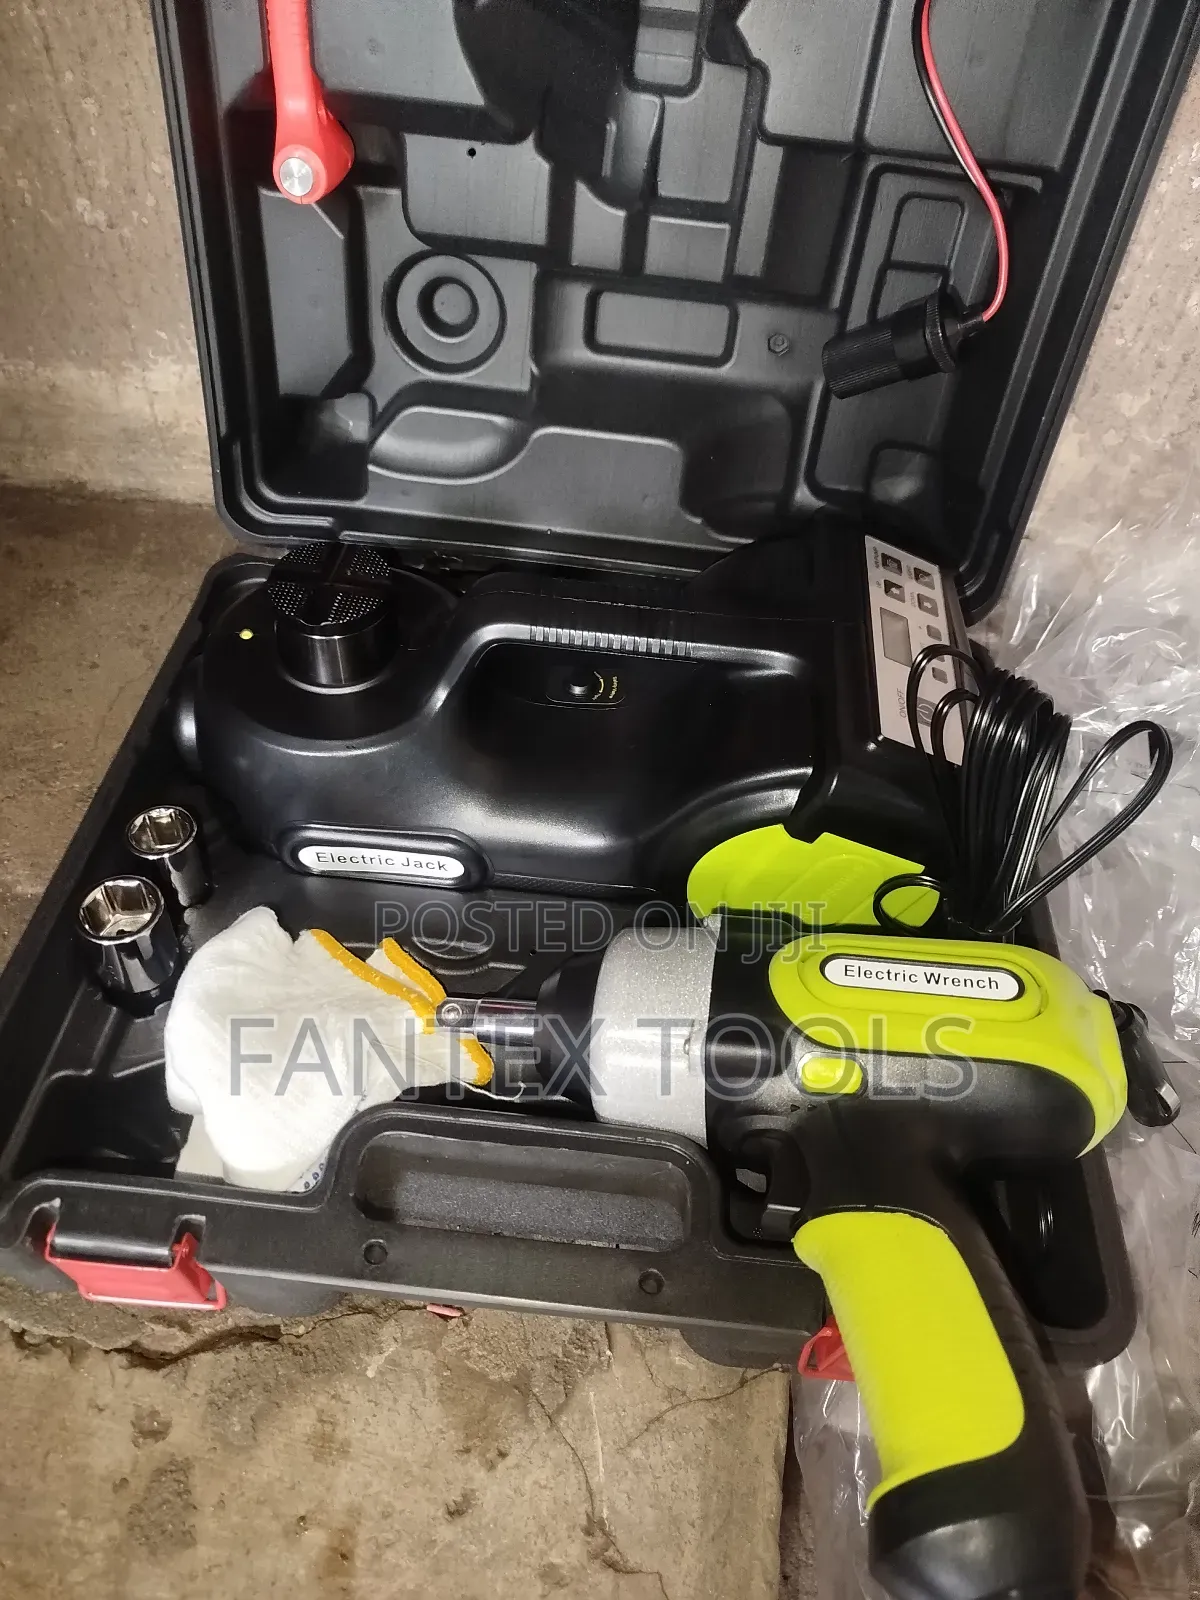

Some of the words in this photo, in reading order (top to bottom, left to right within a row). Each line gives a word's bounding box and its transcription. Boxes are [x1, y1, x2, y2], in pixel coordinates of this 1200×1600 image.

[875, 580, 882, 589] UP
[896, 688, 907, 719] ON/OFF
[316, 852, 396, 867] Electric
[401, 857, 449, 872] Jack
[844, 964, 920, 984] Electric
[924, 971, 1000, 990] Wrench
